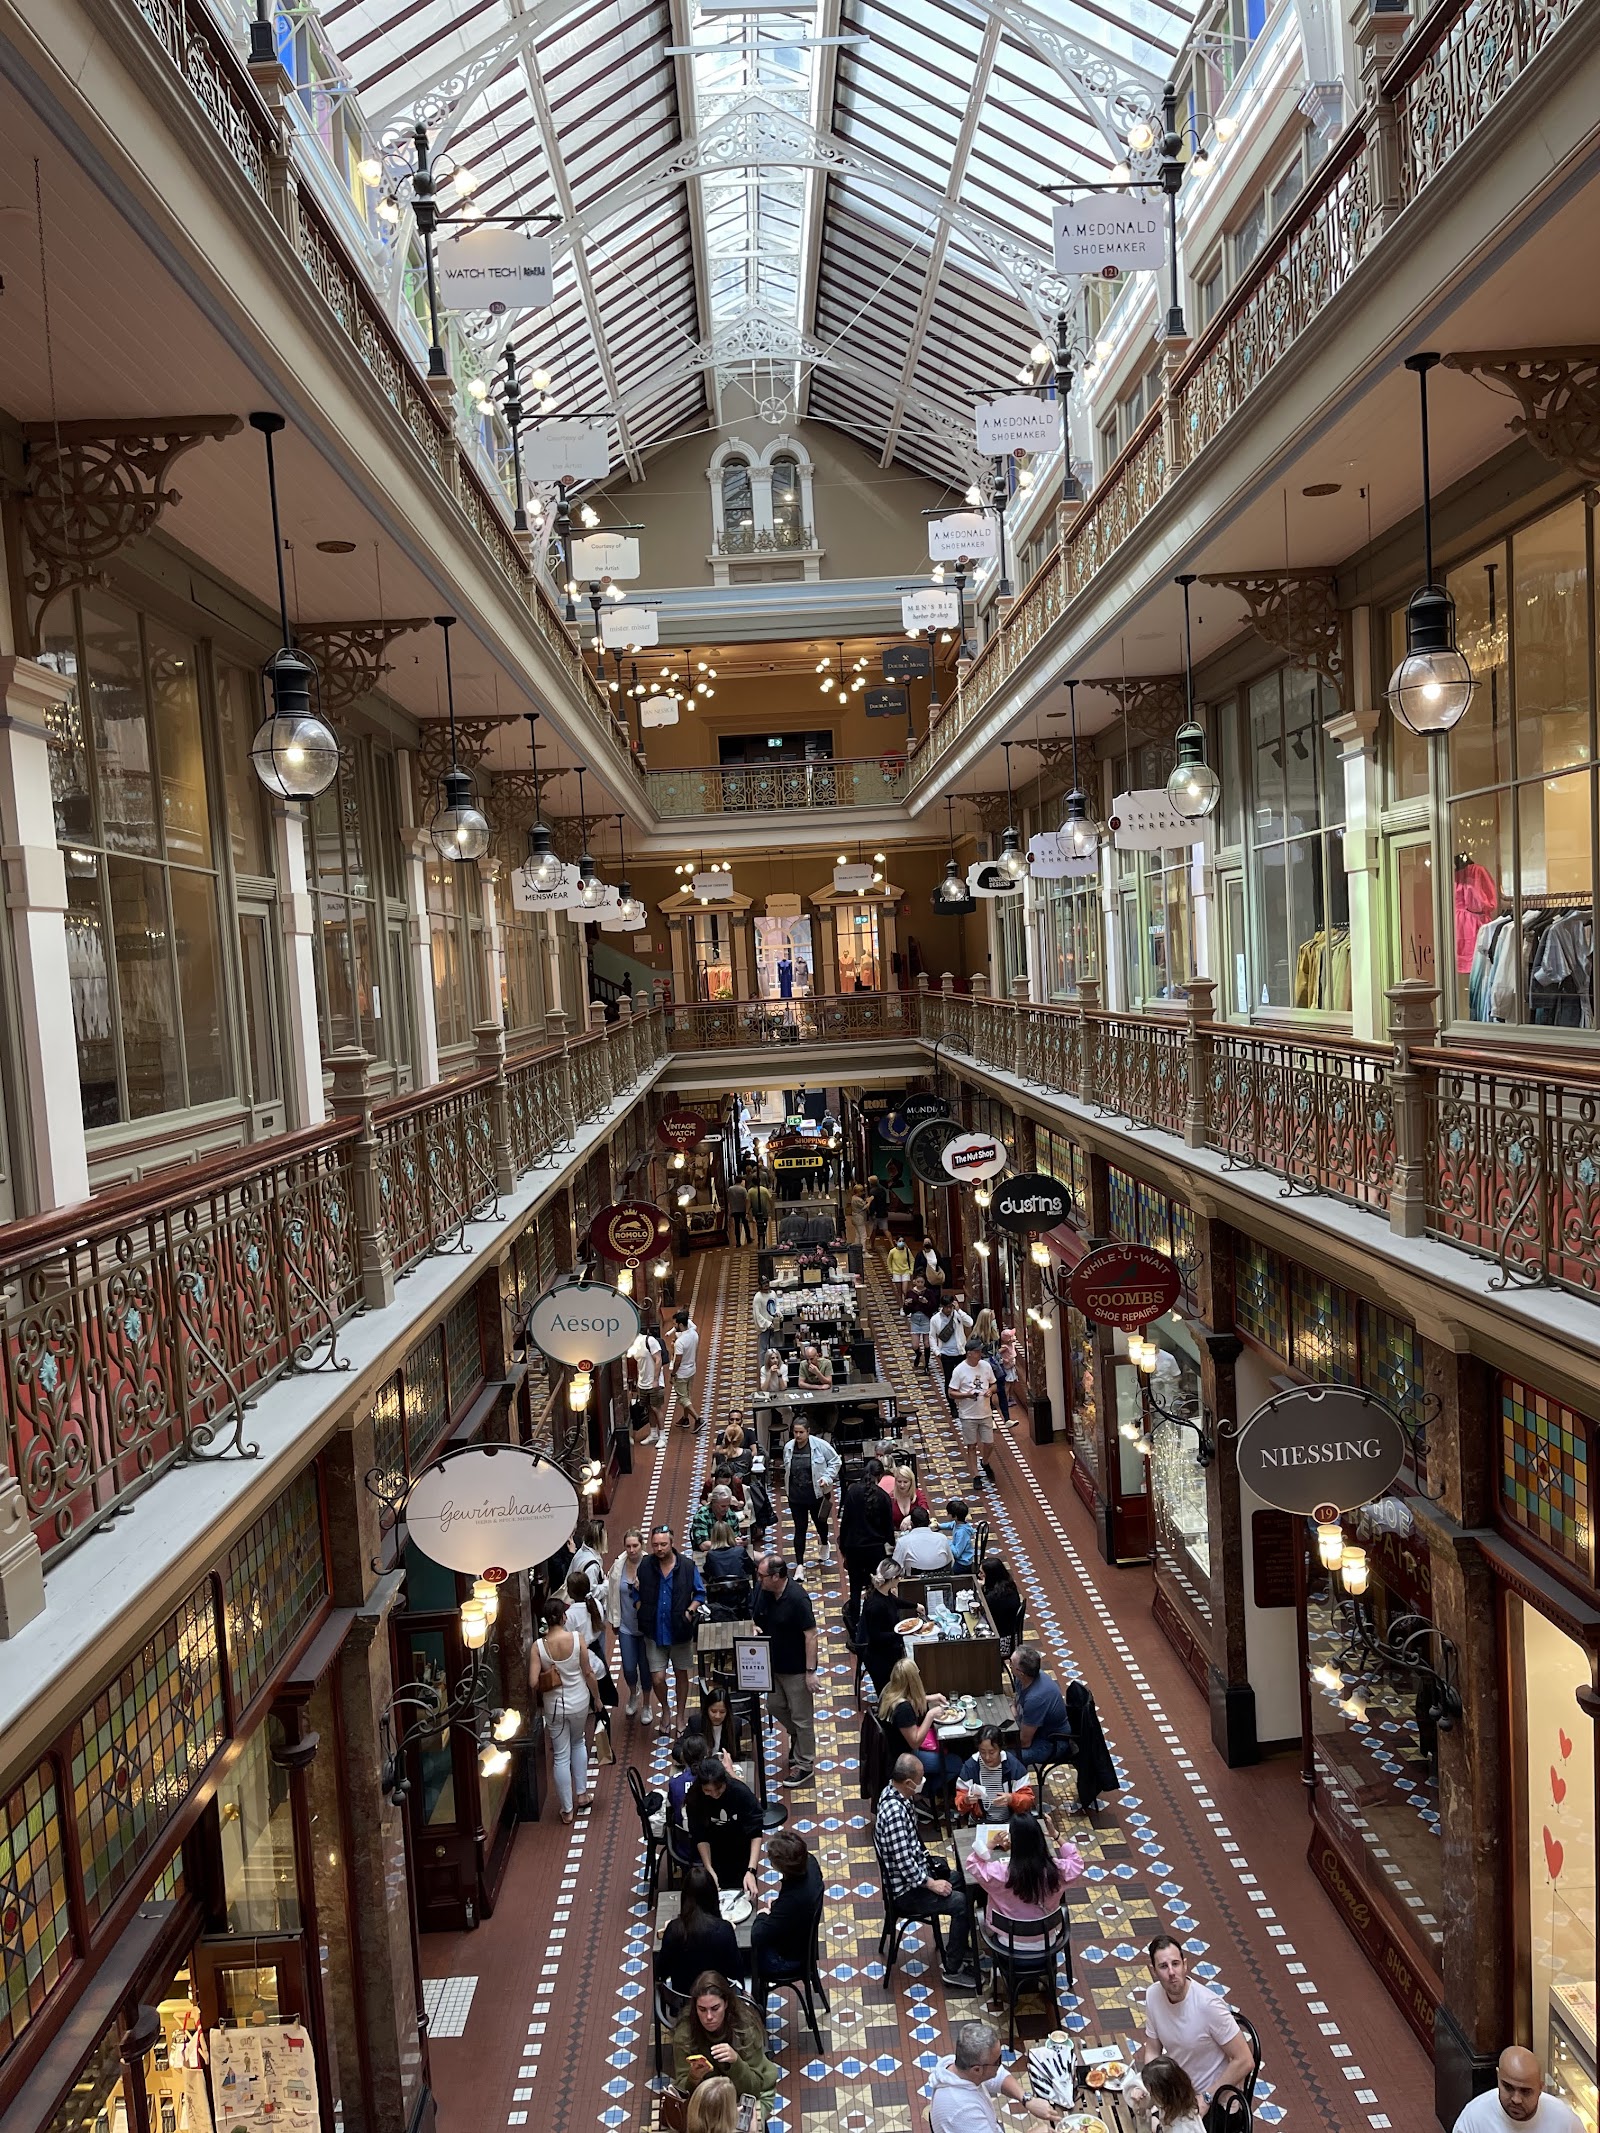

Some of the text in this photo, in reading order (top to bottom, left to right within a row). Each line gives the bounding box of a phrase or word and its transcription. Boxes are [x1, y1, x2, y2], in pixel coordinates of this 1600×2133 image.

[1073, 242, 1146, 255] SHOEMAKER
[445, 267, 485, 279] WATCH
[488, 267, 517, 278] TECH
[1104, 268, 1117, 276] 121
[991, 430, 1046, 441] SHOEMAKER
[564, 462, 582, 470] Artist
[941, 541, 985, 550] SHOEMAKER
[938, 602, 953, 610] BIZ
[937, 611, 948, 619] shop
[1128, 811, 1165, 821] SKIN
[1128, 820, 1196, 831] THREADS
[525, 891, 569, 902] MENSWEAR
[1406, 933, 1435, 976] Aje.
[663, 1117, 696, 1132] VINTAGE
[669, 1129, 696, 1137] WATCH
[794, 1136, 827, 1146] SHOPPING
[954, 1149, 995, 1165] The Nut Shop
[778, 1158, 793, 1168] JB
[999, 1194, 1063, 1215] dustins
[615, 1231, 648, 1239] ROMOLO
[1029, 1230, 1037, 1238] 23
[1086, 1290, 1165, 1308] COOMBS
[1094, 1304, 1159, 1322] SHOE REPAIRS
[581, 1362, 591, 1370] 20
[1260, 1438, 1383, 1469] NIESSING
[517, 1514, 554, 1522] MERCHANTS
[1320, 1508, 1334, 1520] 19
[489, 1569, 503, 1581] 22
[1322, 1849, 1371, 1930] Coombs
[1386, 1947, 1412, 1995] SHOE
